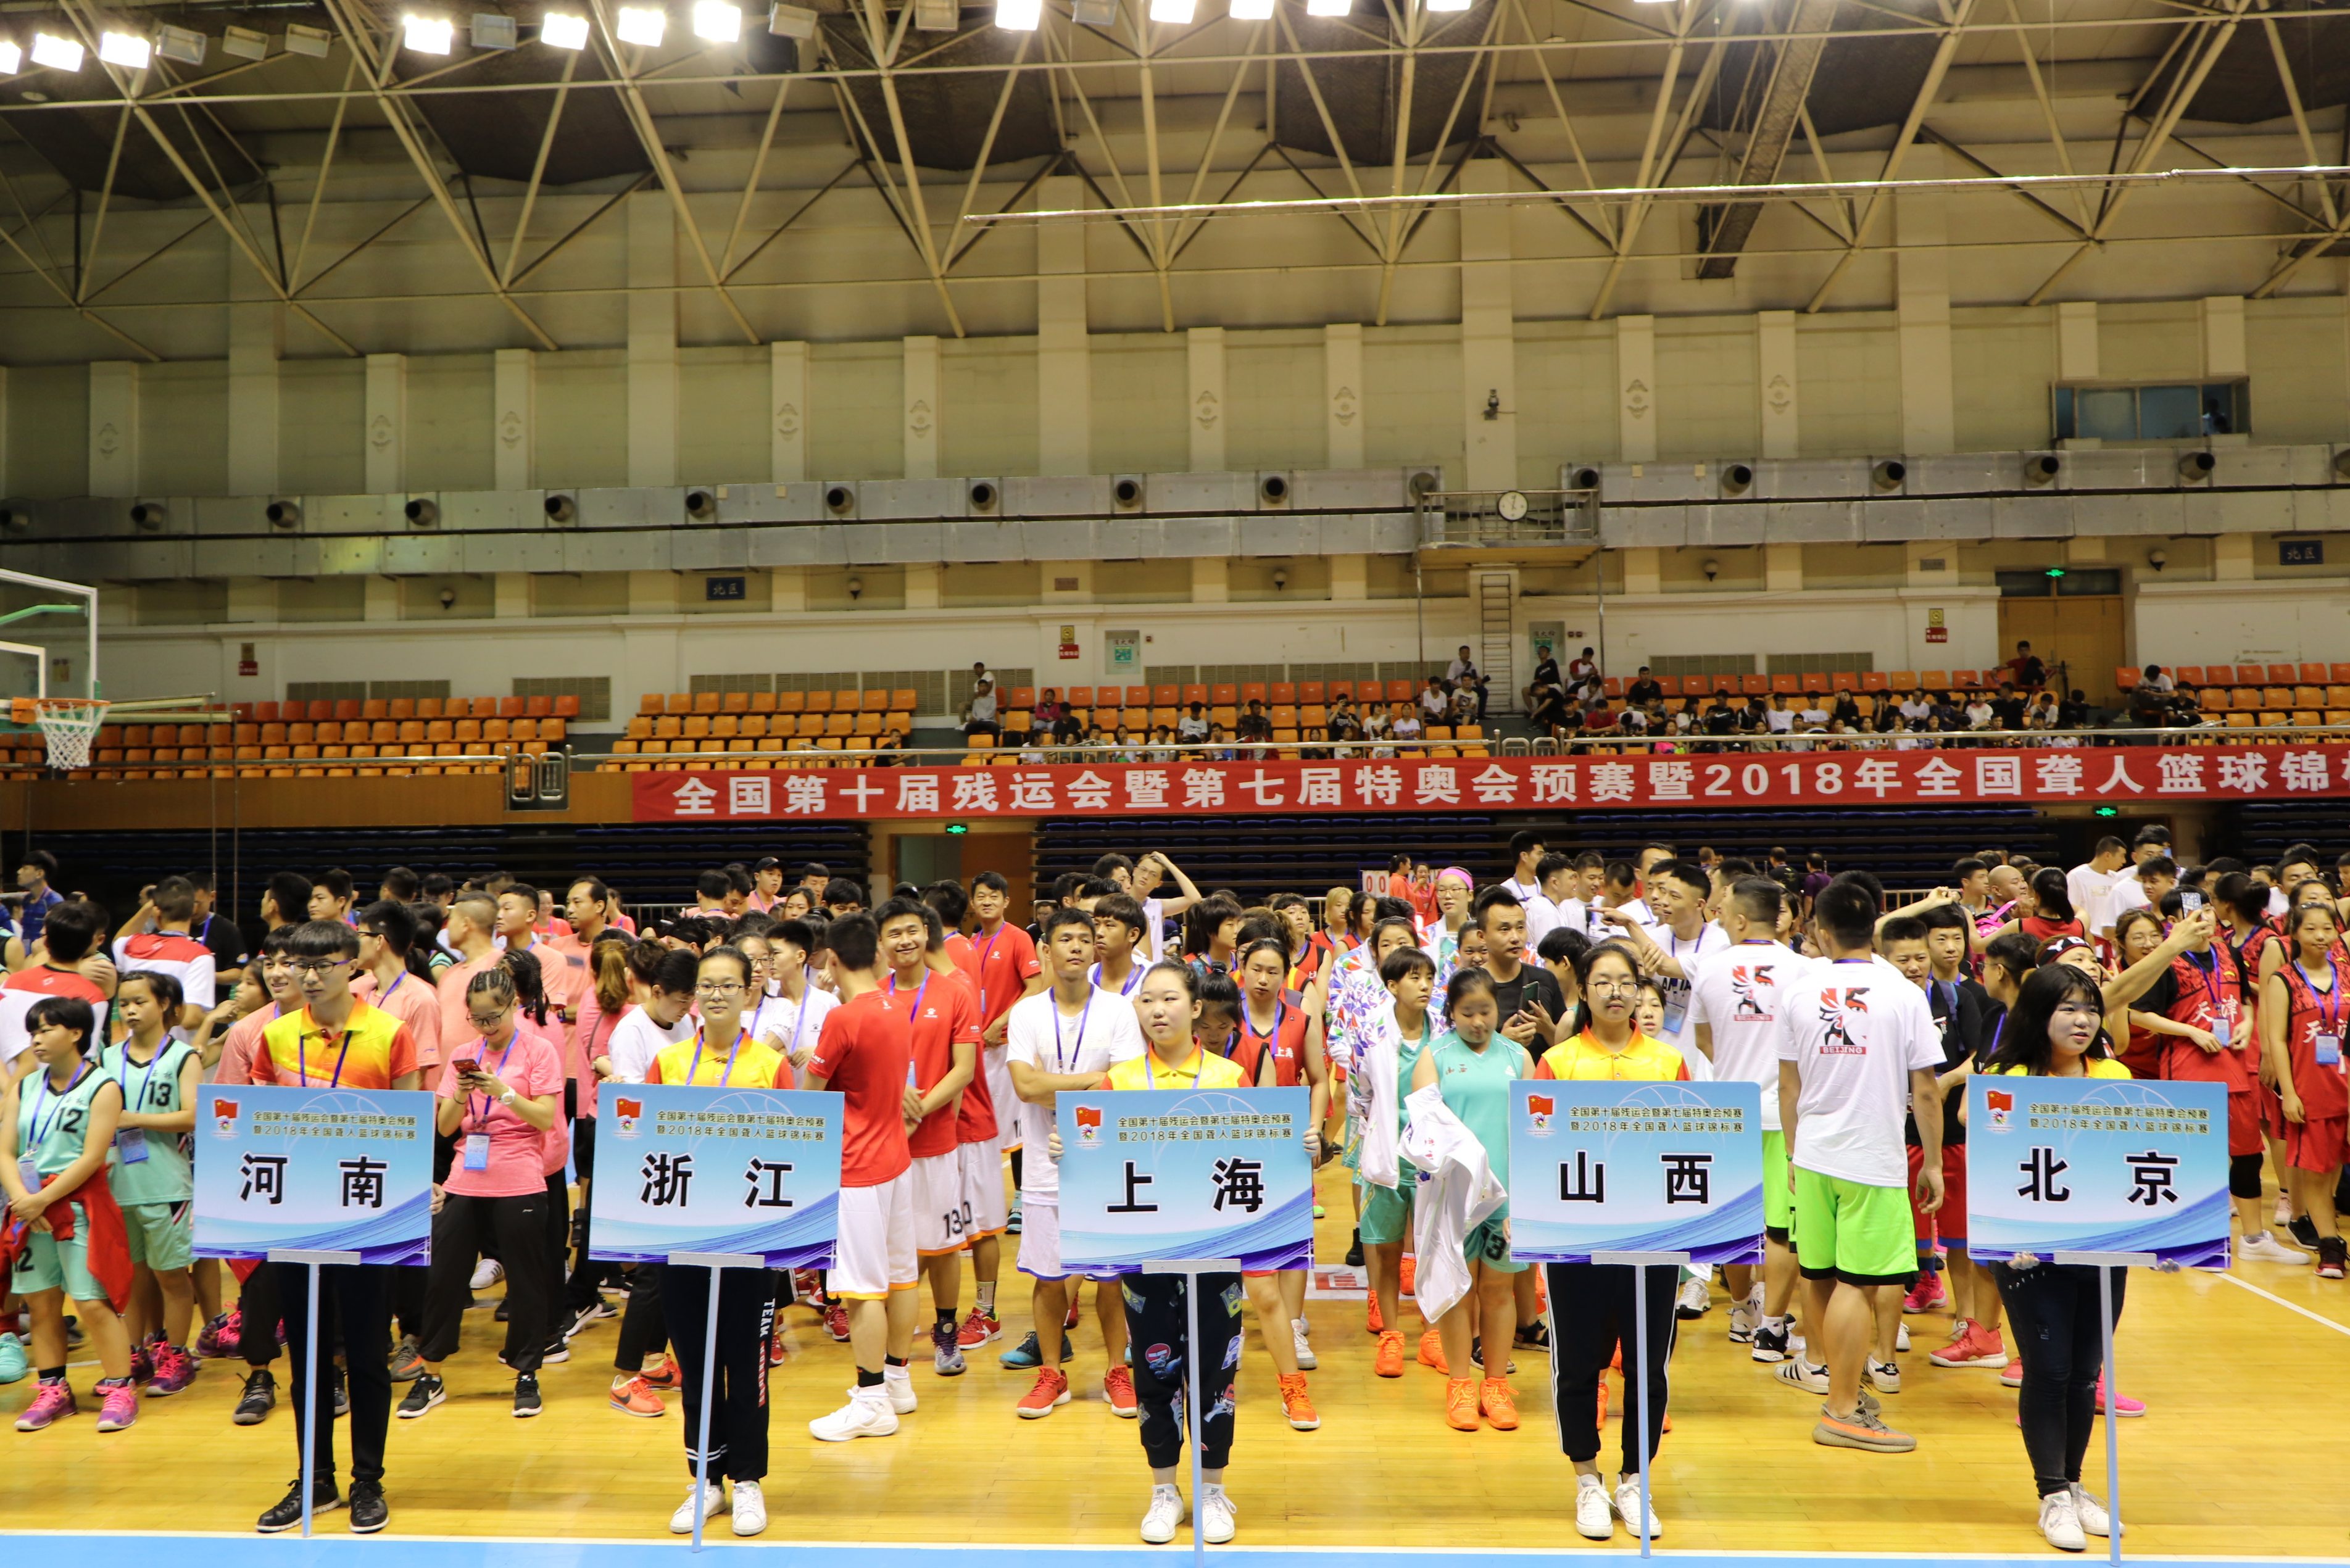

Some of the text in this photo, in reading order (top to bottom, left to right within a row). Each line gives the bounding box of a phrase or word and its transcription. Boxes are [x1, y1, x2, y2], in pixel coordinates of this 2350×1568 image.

[2287, 546, 2315, 560] 北区
[713, 582, 739, 595] 北区
[673, 749, 2350, 816] 全国第十届残运会暨第七届特奥会预赛暨2018年全国聋人篮球锦
[2191, 993, 2238, 1024] 天津
[1274, 1047, 1294, 1058] 上海
[147, 1081, 172, 1107] 13
[56, 1107, 83, 1134] 12
[253, 1110, 417, 1126] 全国第十届残运会暨第七届特奥会预赛
[656, 1110, 826, 1127] 全国第十届残运会暨第七届特奥会预赛
[1118, 1113, 1292, 1127] 全国第十届残运会暨第七届特奥会预赛
[1569, 1106, 1743, 1118] 全国第十届残运会暨第七届特奥会预赛
[2028, 1102, 2209, 1121] 全国第十届残运会暨第七届特奥会预赛
[253, 1124, 417, 1140] 暨2018年全国聋人篮球锦标赛
[656, 1125, 825, 1141] 暨2018年全国聋人篮球锦标赛
[1118, 1127, 1292, 1142] 暨2018年全国聋人篮球锦标赛
[1571, 1120, 1743, 1133] 暨2018年全国聋人篮球锦标赛
[2028, 1118, 2209, 1134] 暨2018年全国聋人篮球锦标赛
[239, 1152, 388, 1208] 河南
[640, 1153, 794, 1208] 浙江
[1106, 1158, 1264, 1213] 上海
[1559, 1151, 1713, 1204] 山西
[2017, 1148, 2179, 1206] 北京
[943, 1208, 963, 1238] 13
[15, 1246, 35, 1272] 2
[760, 1298, 776, 1338] TEAM
